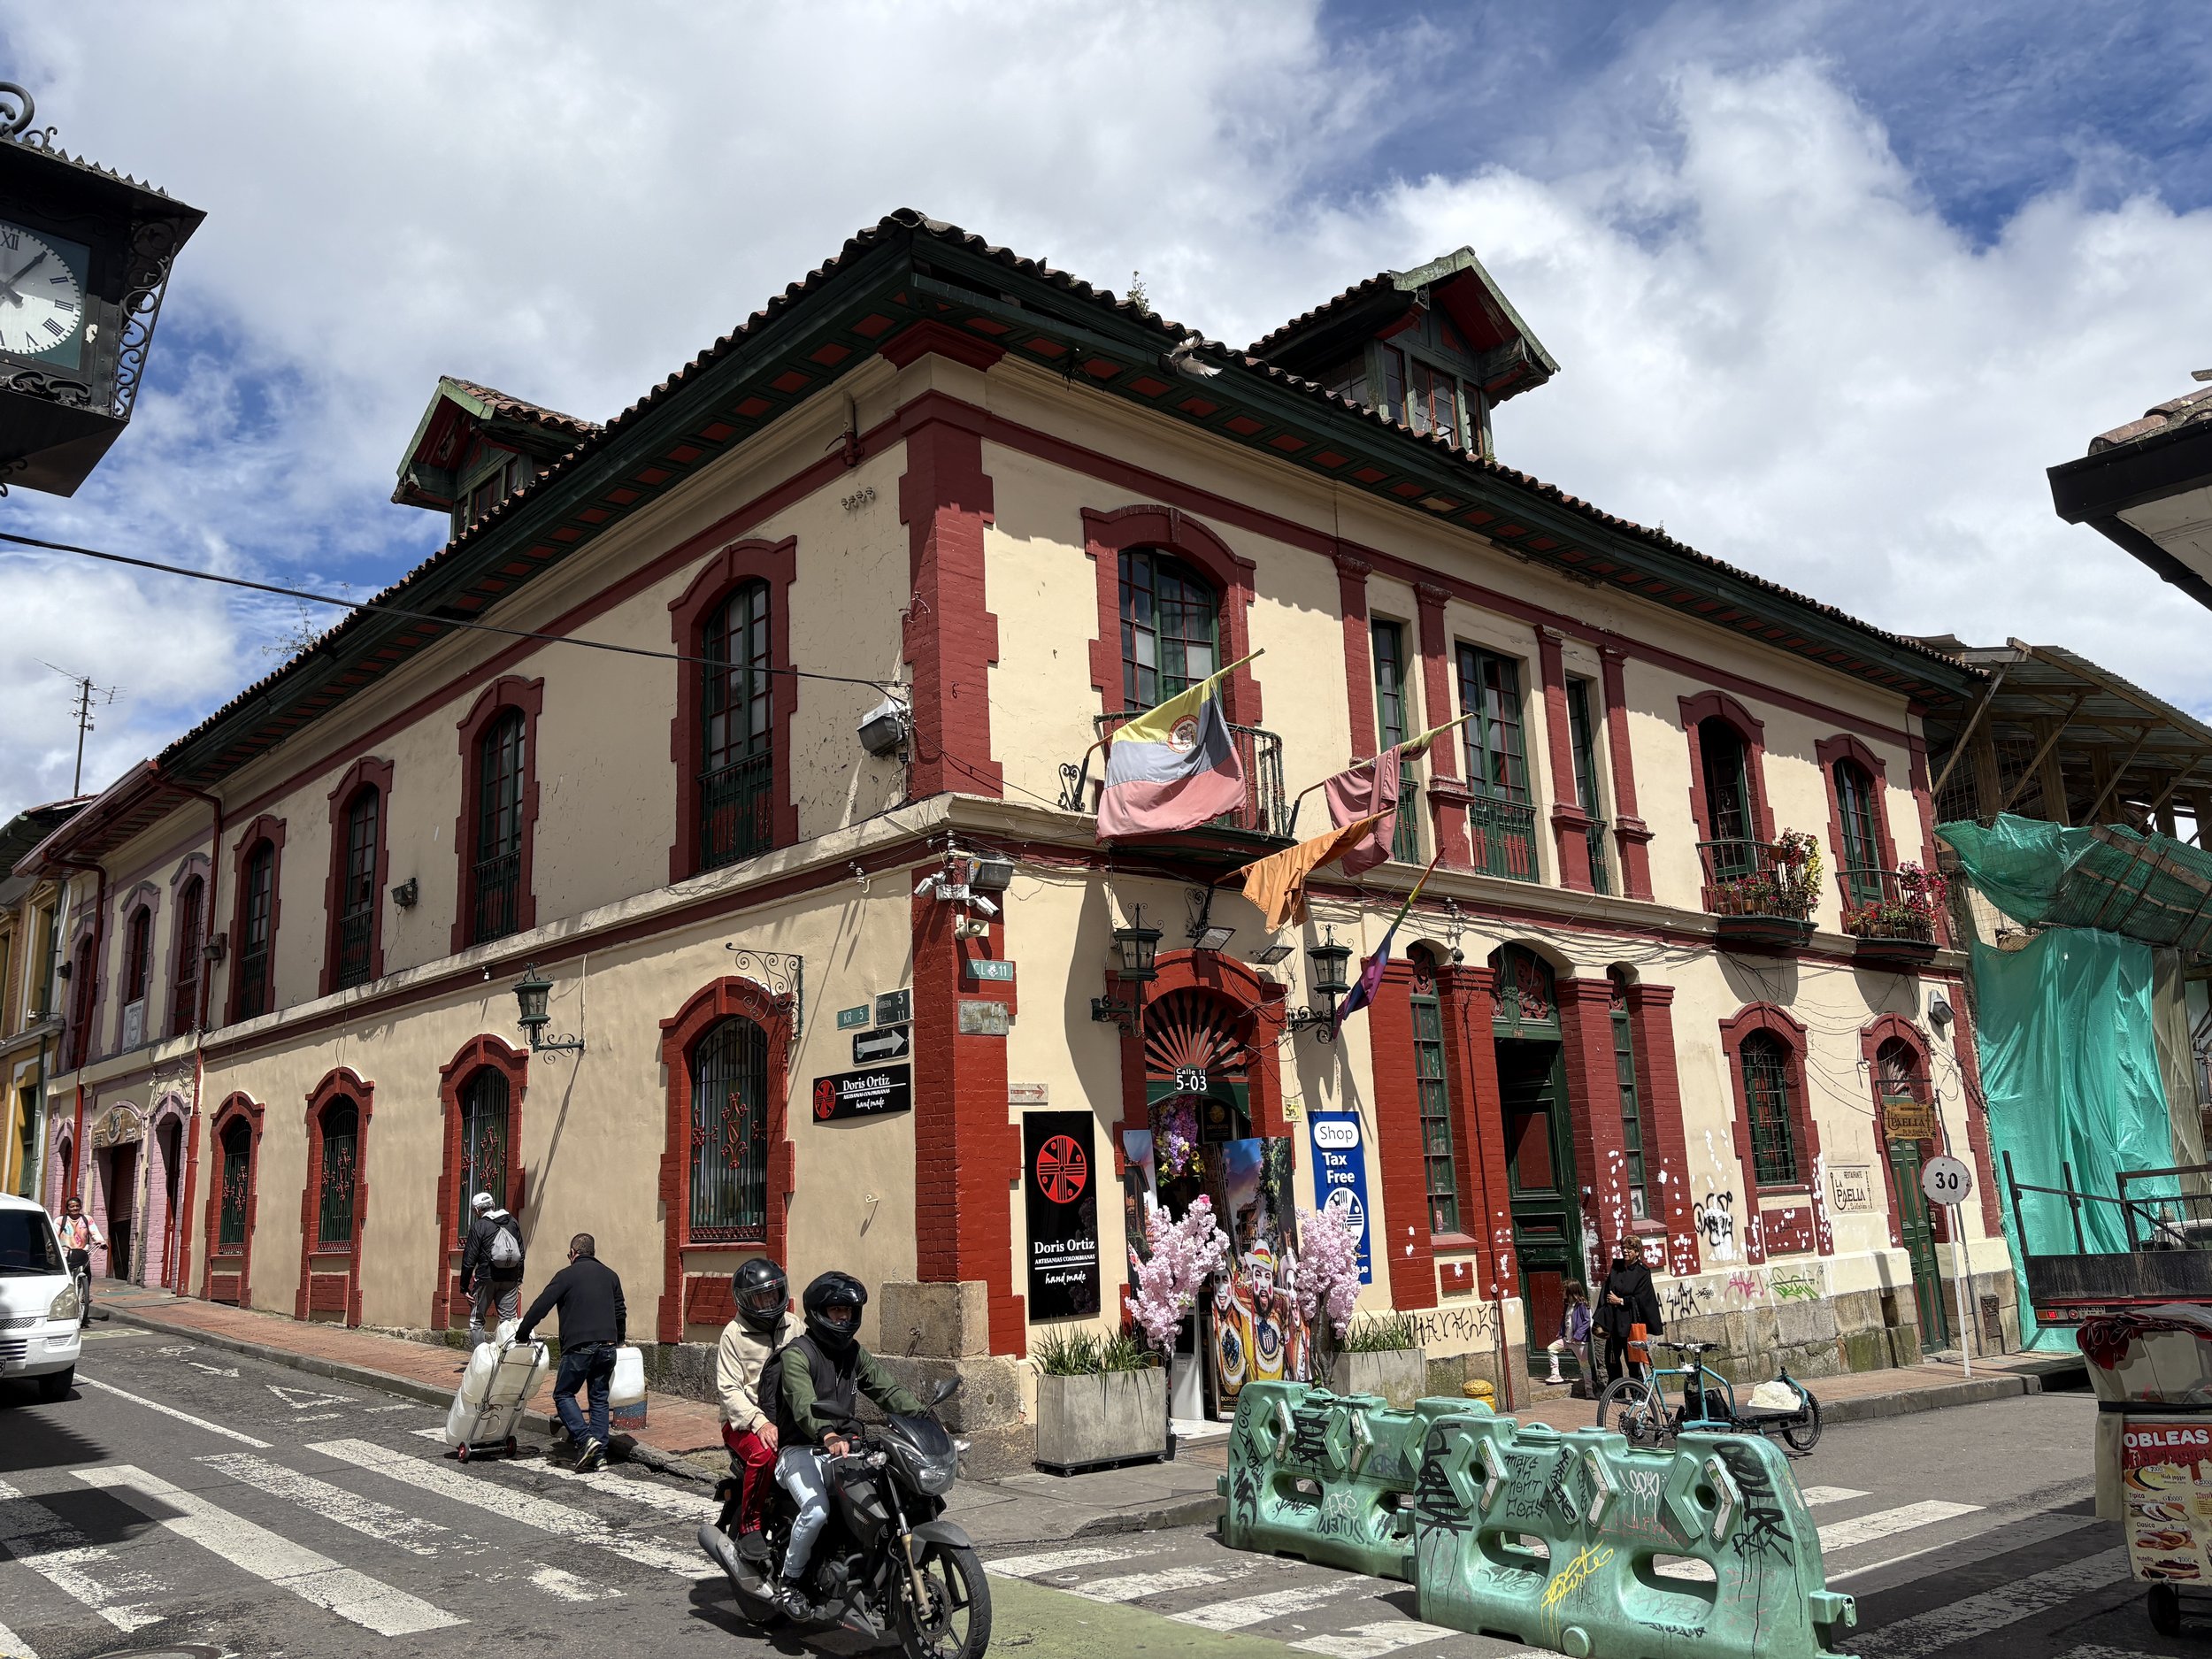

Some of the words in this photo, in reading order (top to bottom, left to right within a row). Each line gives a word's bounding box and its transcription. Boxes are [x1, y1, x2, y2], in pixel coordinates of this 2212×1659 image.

[973, 963, 986, 975] CL
[999, 965, 1007, 977] 11
[898, 992, 903, 1004] 5
[843, 1013, 852, 1024] KR
[858, 1008, 864, 1020] 5
[897, 1010, 905, 1021] 11
[842, 1078, 865, 1091] Doris
[866, 1074, 890, 1087] Ortiz
[1176, 1075, 1207, 1091] 5-03
[1891, 1118, 1926, 1127] PAELLA
[1319, 1126, 1353, 1142] Shop
[1322, 1152, 1348, 1165] Tax
[1327, 1170, 1355, 1184] Free
[1935, 1171, 1959, 1190] 30
[1836, 1187, 1866, 1202] PAELLA
[1034, 1240, 1064, 1254] Doris
[1067, 1237, 1094, 1251] Ortiz
[1034, 1256, 1063, 1265] ARTESANIAS
[2124, 1429, 2210, 1448] OBLEAS
